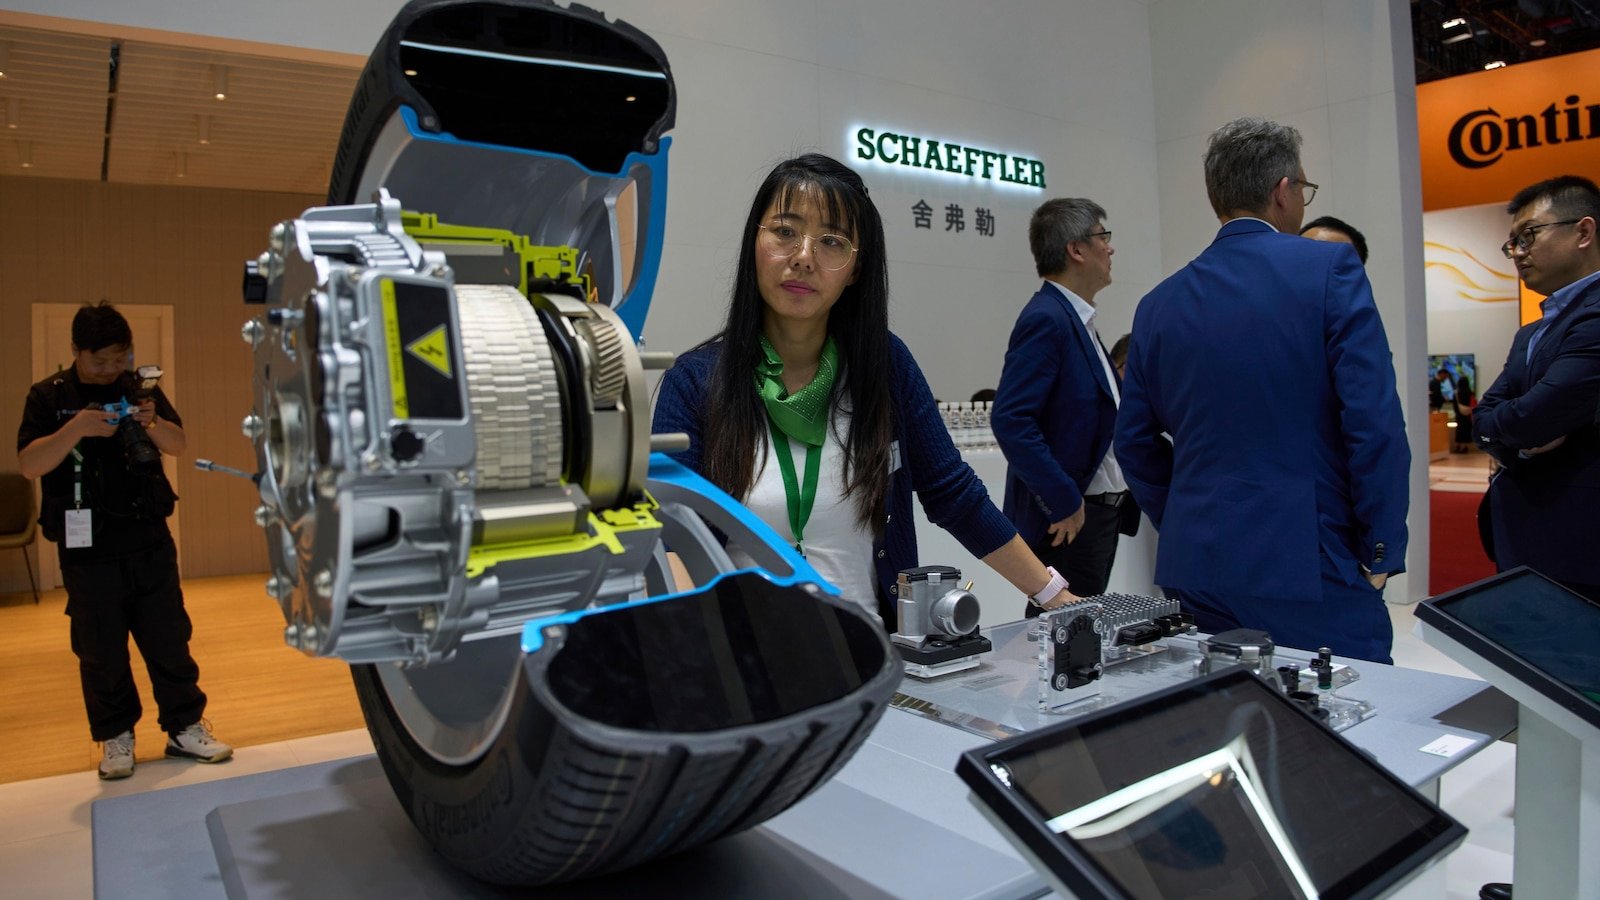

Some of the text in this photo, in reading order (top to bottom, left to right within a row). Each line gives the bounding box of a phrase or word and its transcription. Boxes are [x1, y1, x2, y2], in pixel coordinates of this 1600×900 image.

[857, 128, 1046, 188] SCHAEFFLER
[911, 199, 995, 237] 舍弗勒
